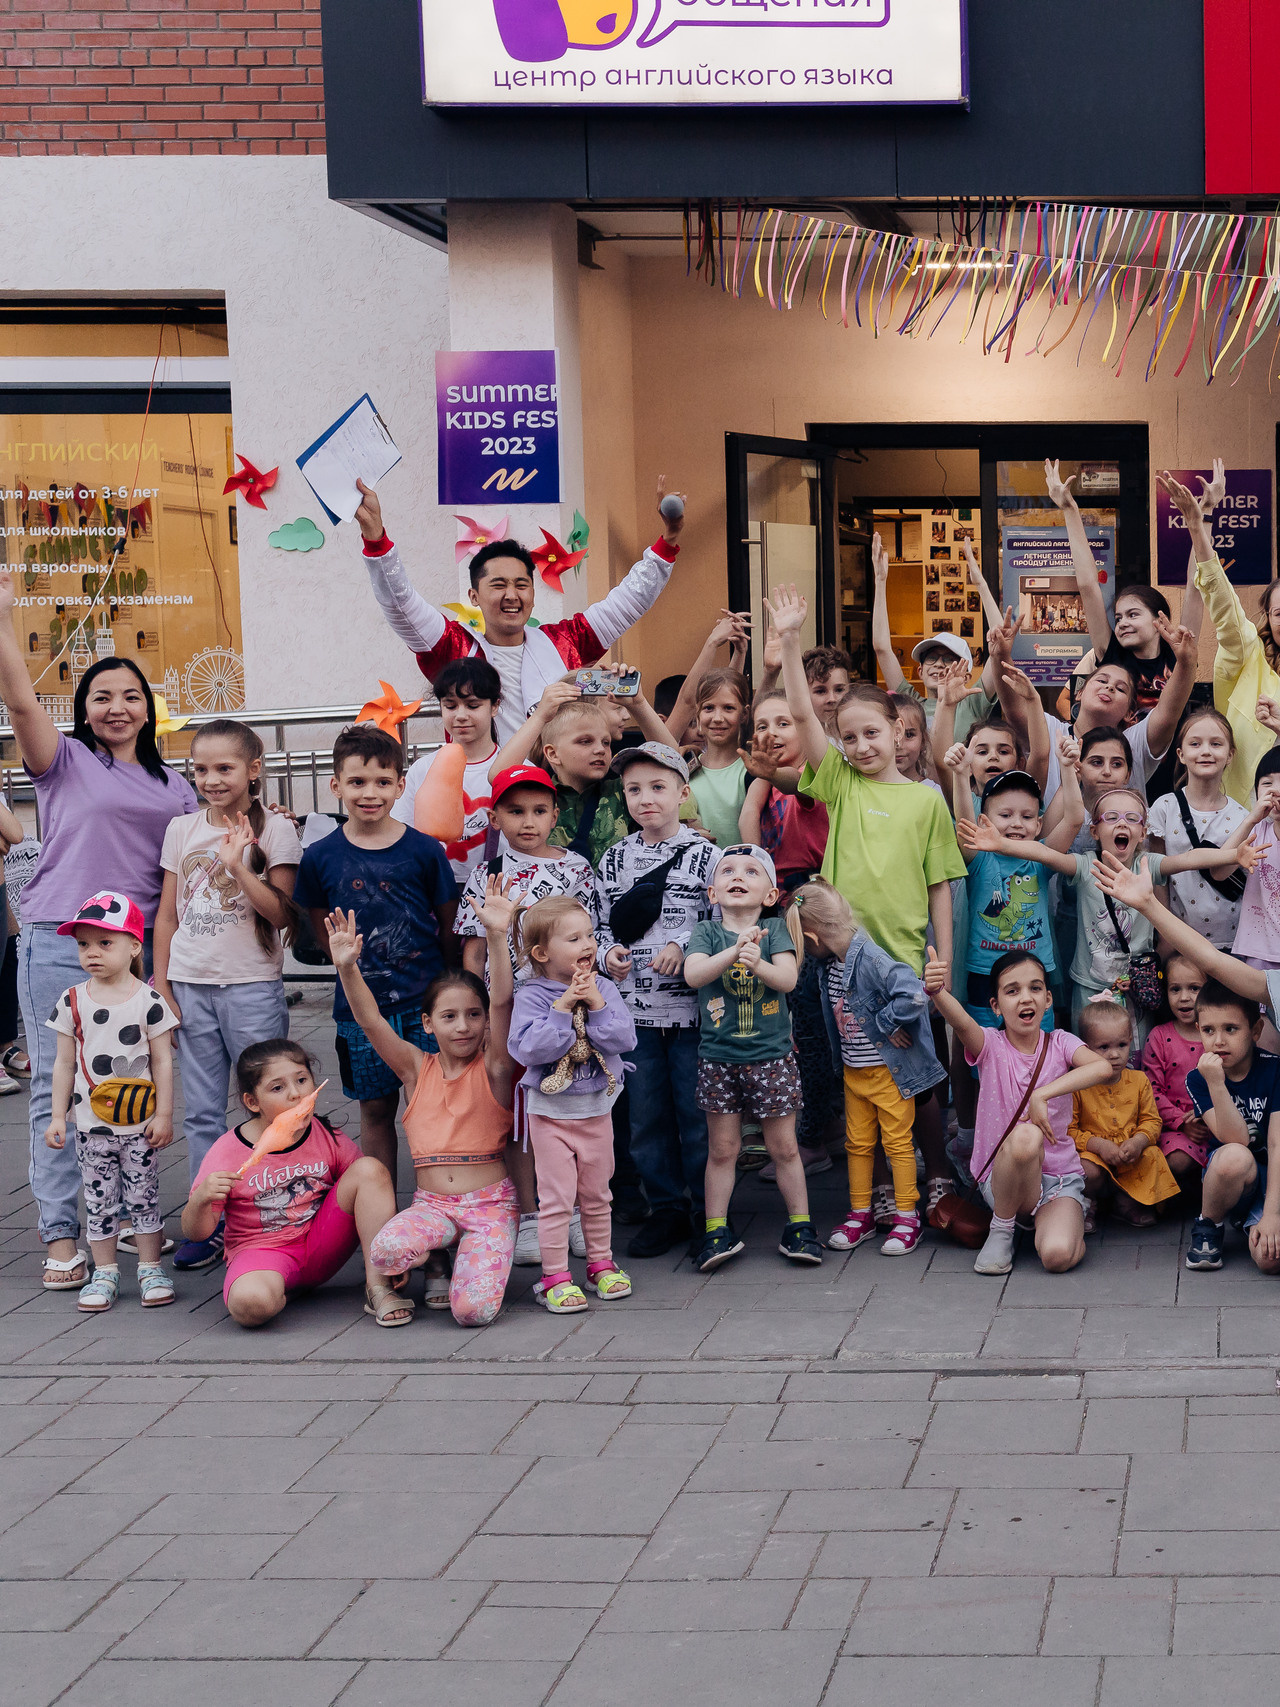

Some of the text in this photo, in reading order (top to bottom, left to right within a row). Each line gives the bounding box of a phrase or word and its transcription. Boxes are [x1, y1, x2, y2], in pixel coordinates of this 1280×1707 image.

[494, 63, 893, 92] центр английского языка
[445, 410, 559, 430] KIDS FES
[480, 436, 537, 456] 2023
[28, 486, 74, 500] детей
[79, 489, 96, 499] от
[101, 486, 128, 499] 3-6
[133, 487, 159, 499] лет
[1218, 514, 1261, 529] FEST
[29, 526, 126, 536] школьников
[1210, 535, 1235, 548] 23
[32, 563, 108, 576] взрослых
[13, 594, 193, 607] одготовка к экзаменам
[980, 939, 1037, 951] DINOSAUR
[248, 1161, 330, 1192] Victory
